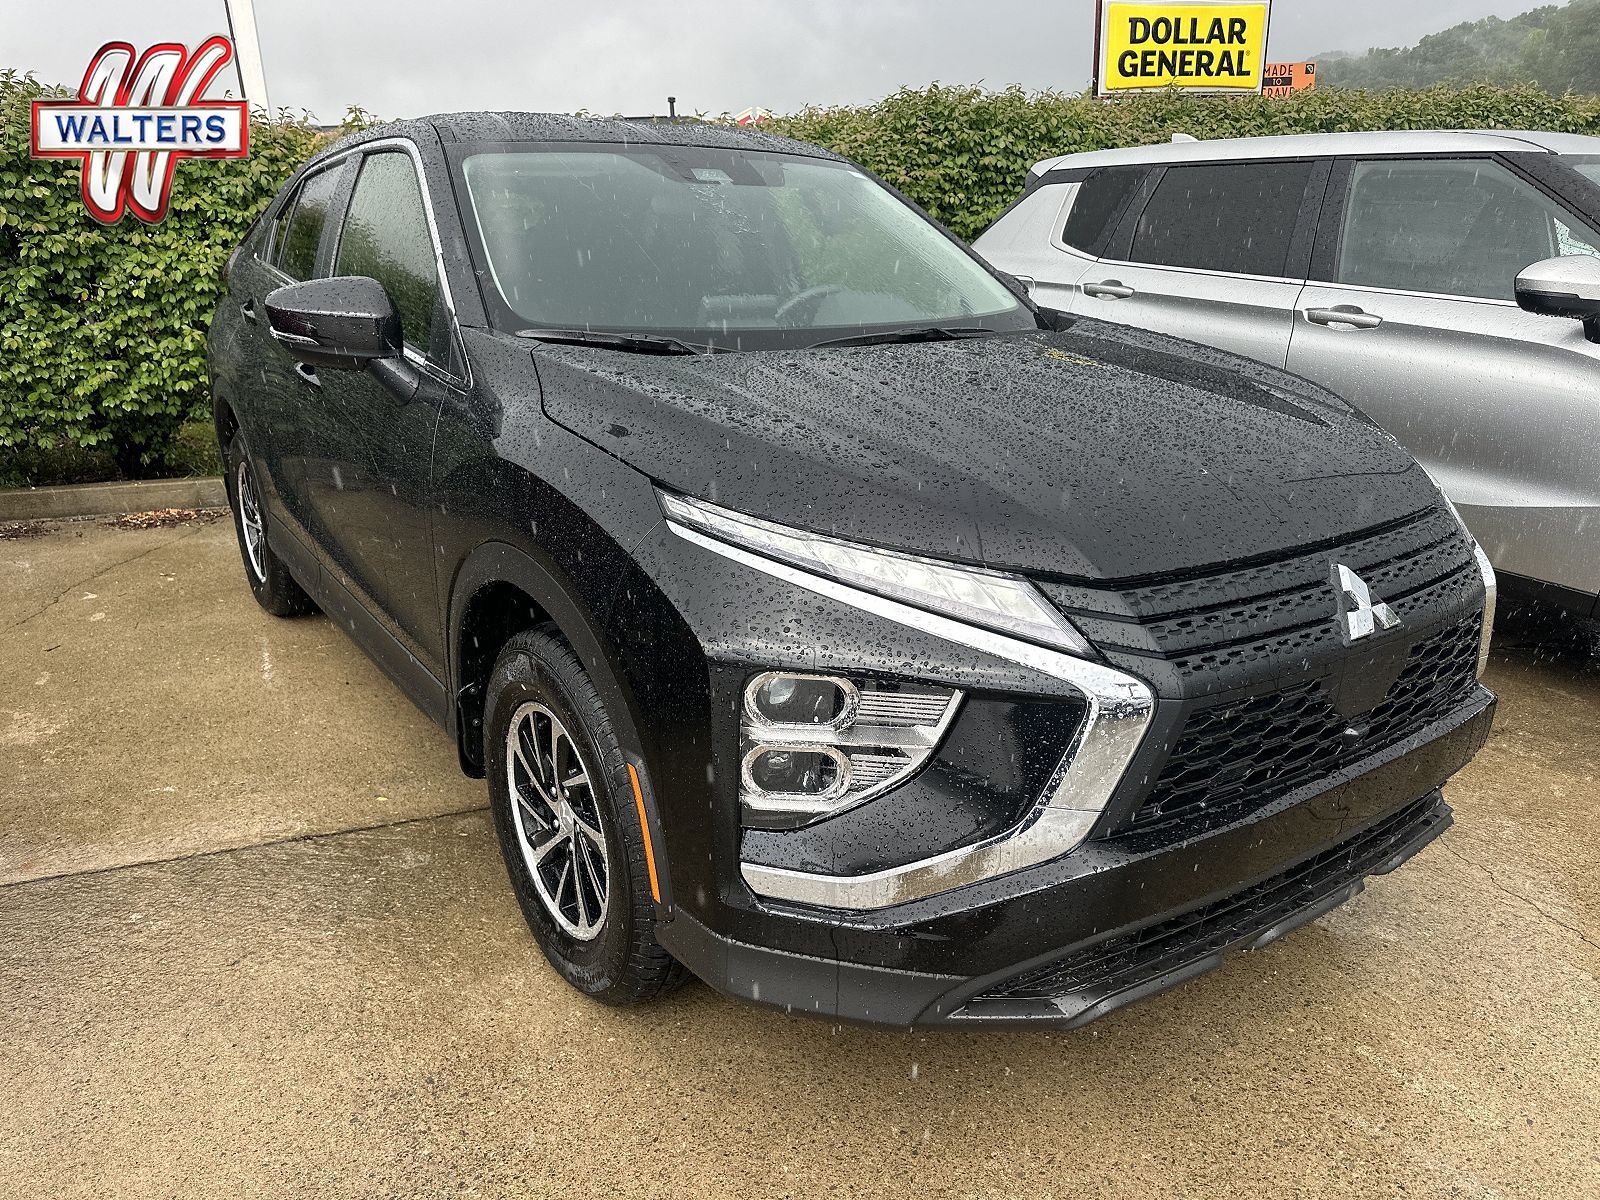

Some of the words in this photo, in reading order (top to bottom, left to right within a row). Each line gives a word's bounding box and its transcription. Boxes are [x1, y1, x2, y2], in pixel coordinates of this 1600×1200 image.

[1128, 17, 1247, 45] DOLLAR
[1117, 50, 1251, 78] GENERAL
[1264, 64, 1294, 77] MADE
[1272, 78, 1283, 86] TO
[1263, 86, 1295, 99] RAVE
